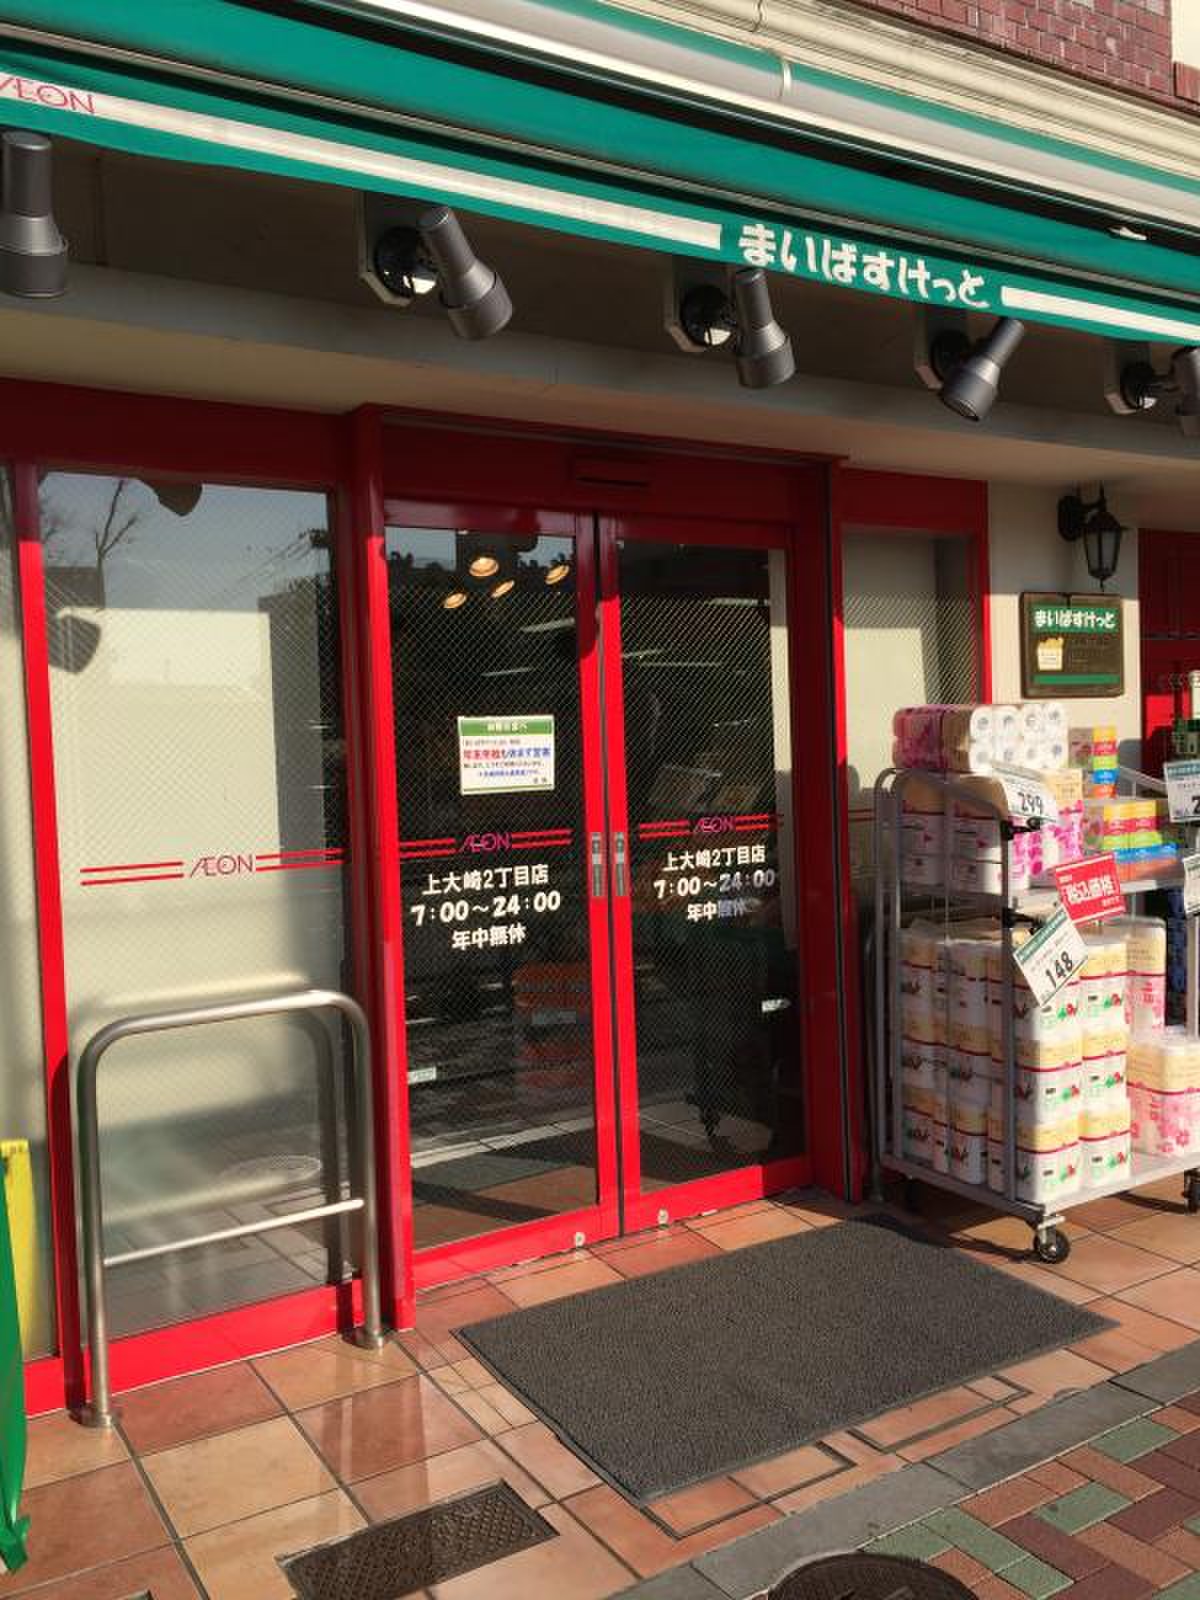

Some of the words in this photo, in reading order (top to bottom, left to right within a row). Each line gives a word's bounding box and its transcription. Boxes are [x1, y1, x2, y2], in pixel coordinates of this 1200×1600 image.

[738, 223, 990, 308] まいばすけっと
[1034, 609, 1116, 629] まいばすけっと
[1017, 792, 1044, 816] 299
[662, 845, 766, 872] 上大崎2丁目店
[422, 864, 549, 896] 上大崎2丁目店
[452, 922, 527, 951] 年中無休
[1045, 951, 1073, 989] 148
